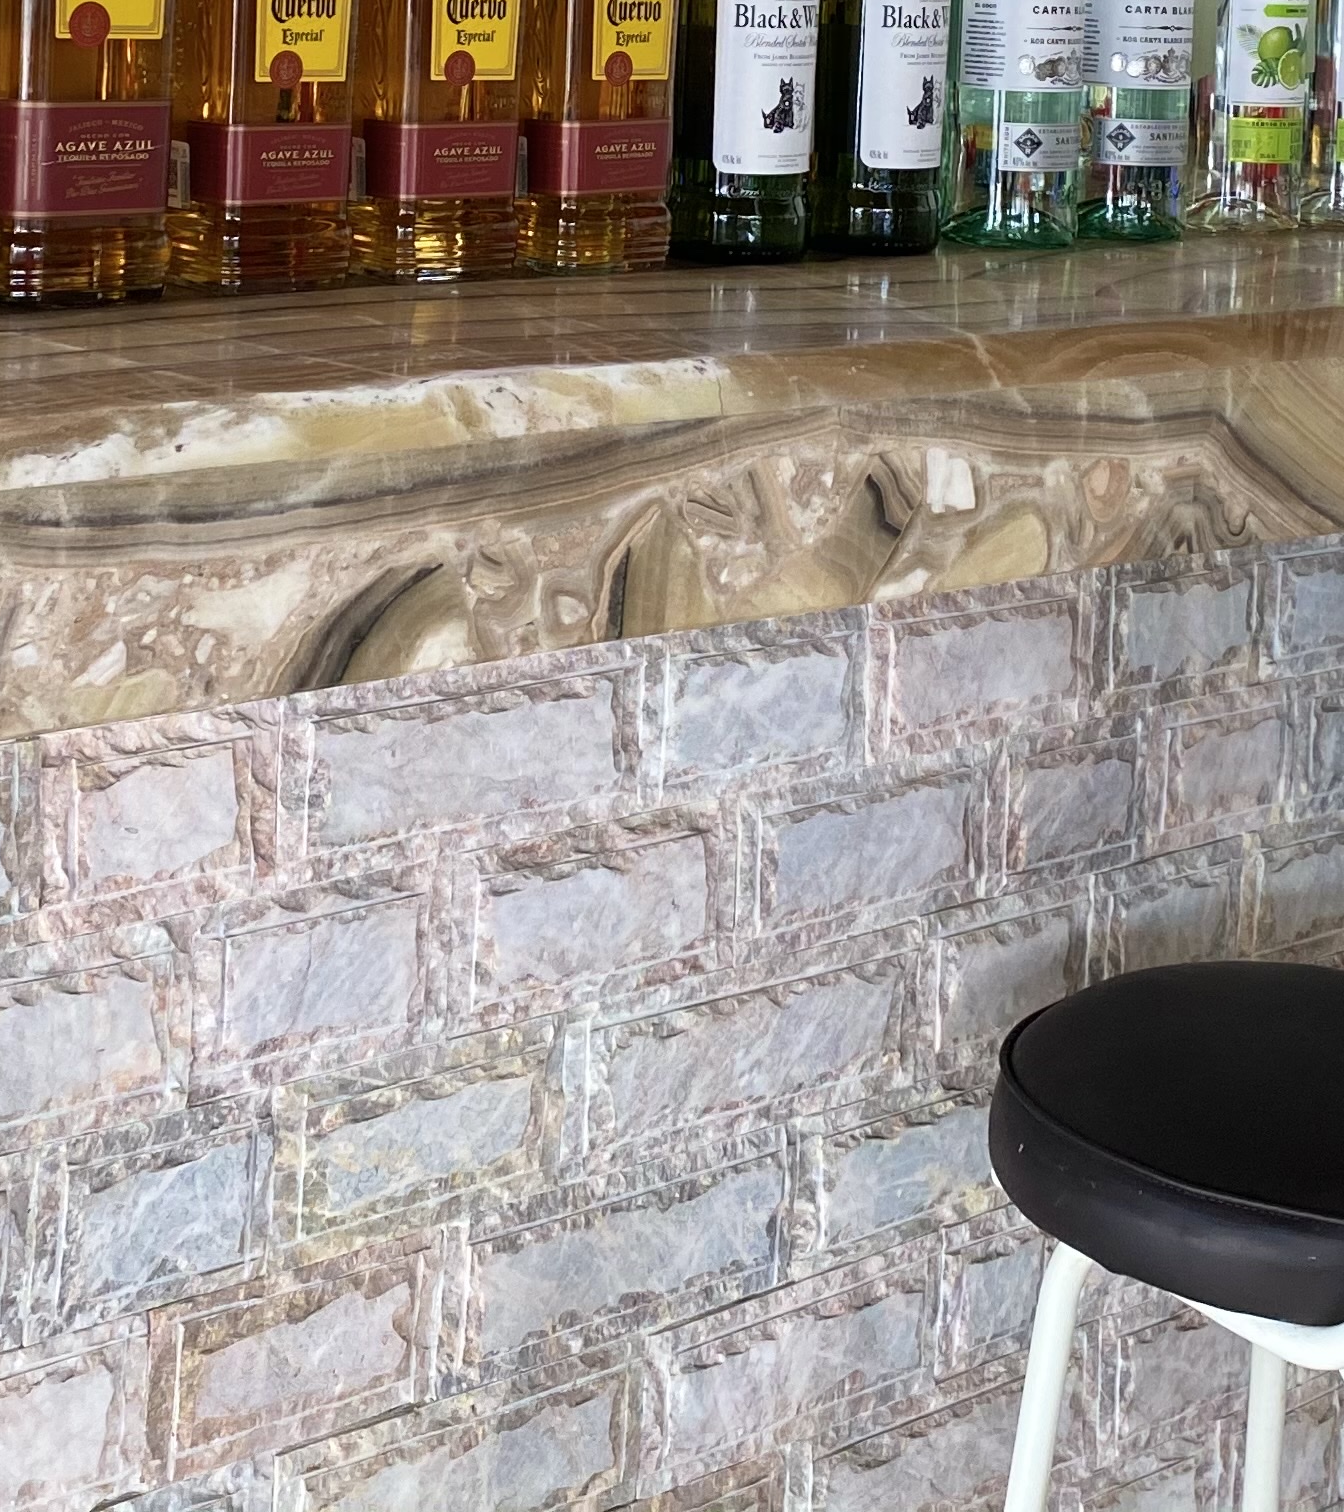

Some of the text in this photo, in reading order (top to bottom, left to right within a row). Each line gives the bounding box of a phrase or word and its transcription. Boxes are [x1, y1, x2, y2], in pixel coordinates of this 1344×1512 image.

[1032, 5, 1071, 15] CARTA
[1125, 5, 1168, 16] CARTA
[281, 28, 325, 46] Especial
[455, 29, 497, 46] Especial
[615, 30, 651, 47] Especial
[55, 139, 155, 153] AGAVE AZUL
[433, 145, 503, 157] AGAVE AZUL
[594, 142, 657, 153] AGAVE AZUL
[260, 149, 335, 160] AGAVE AZUL
